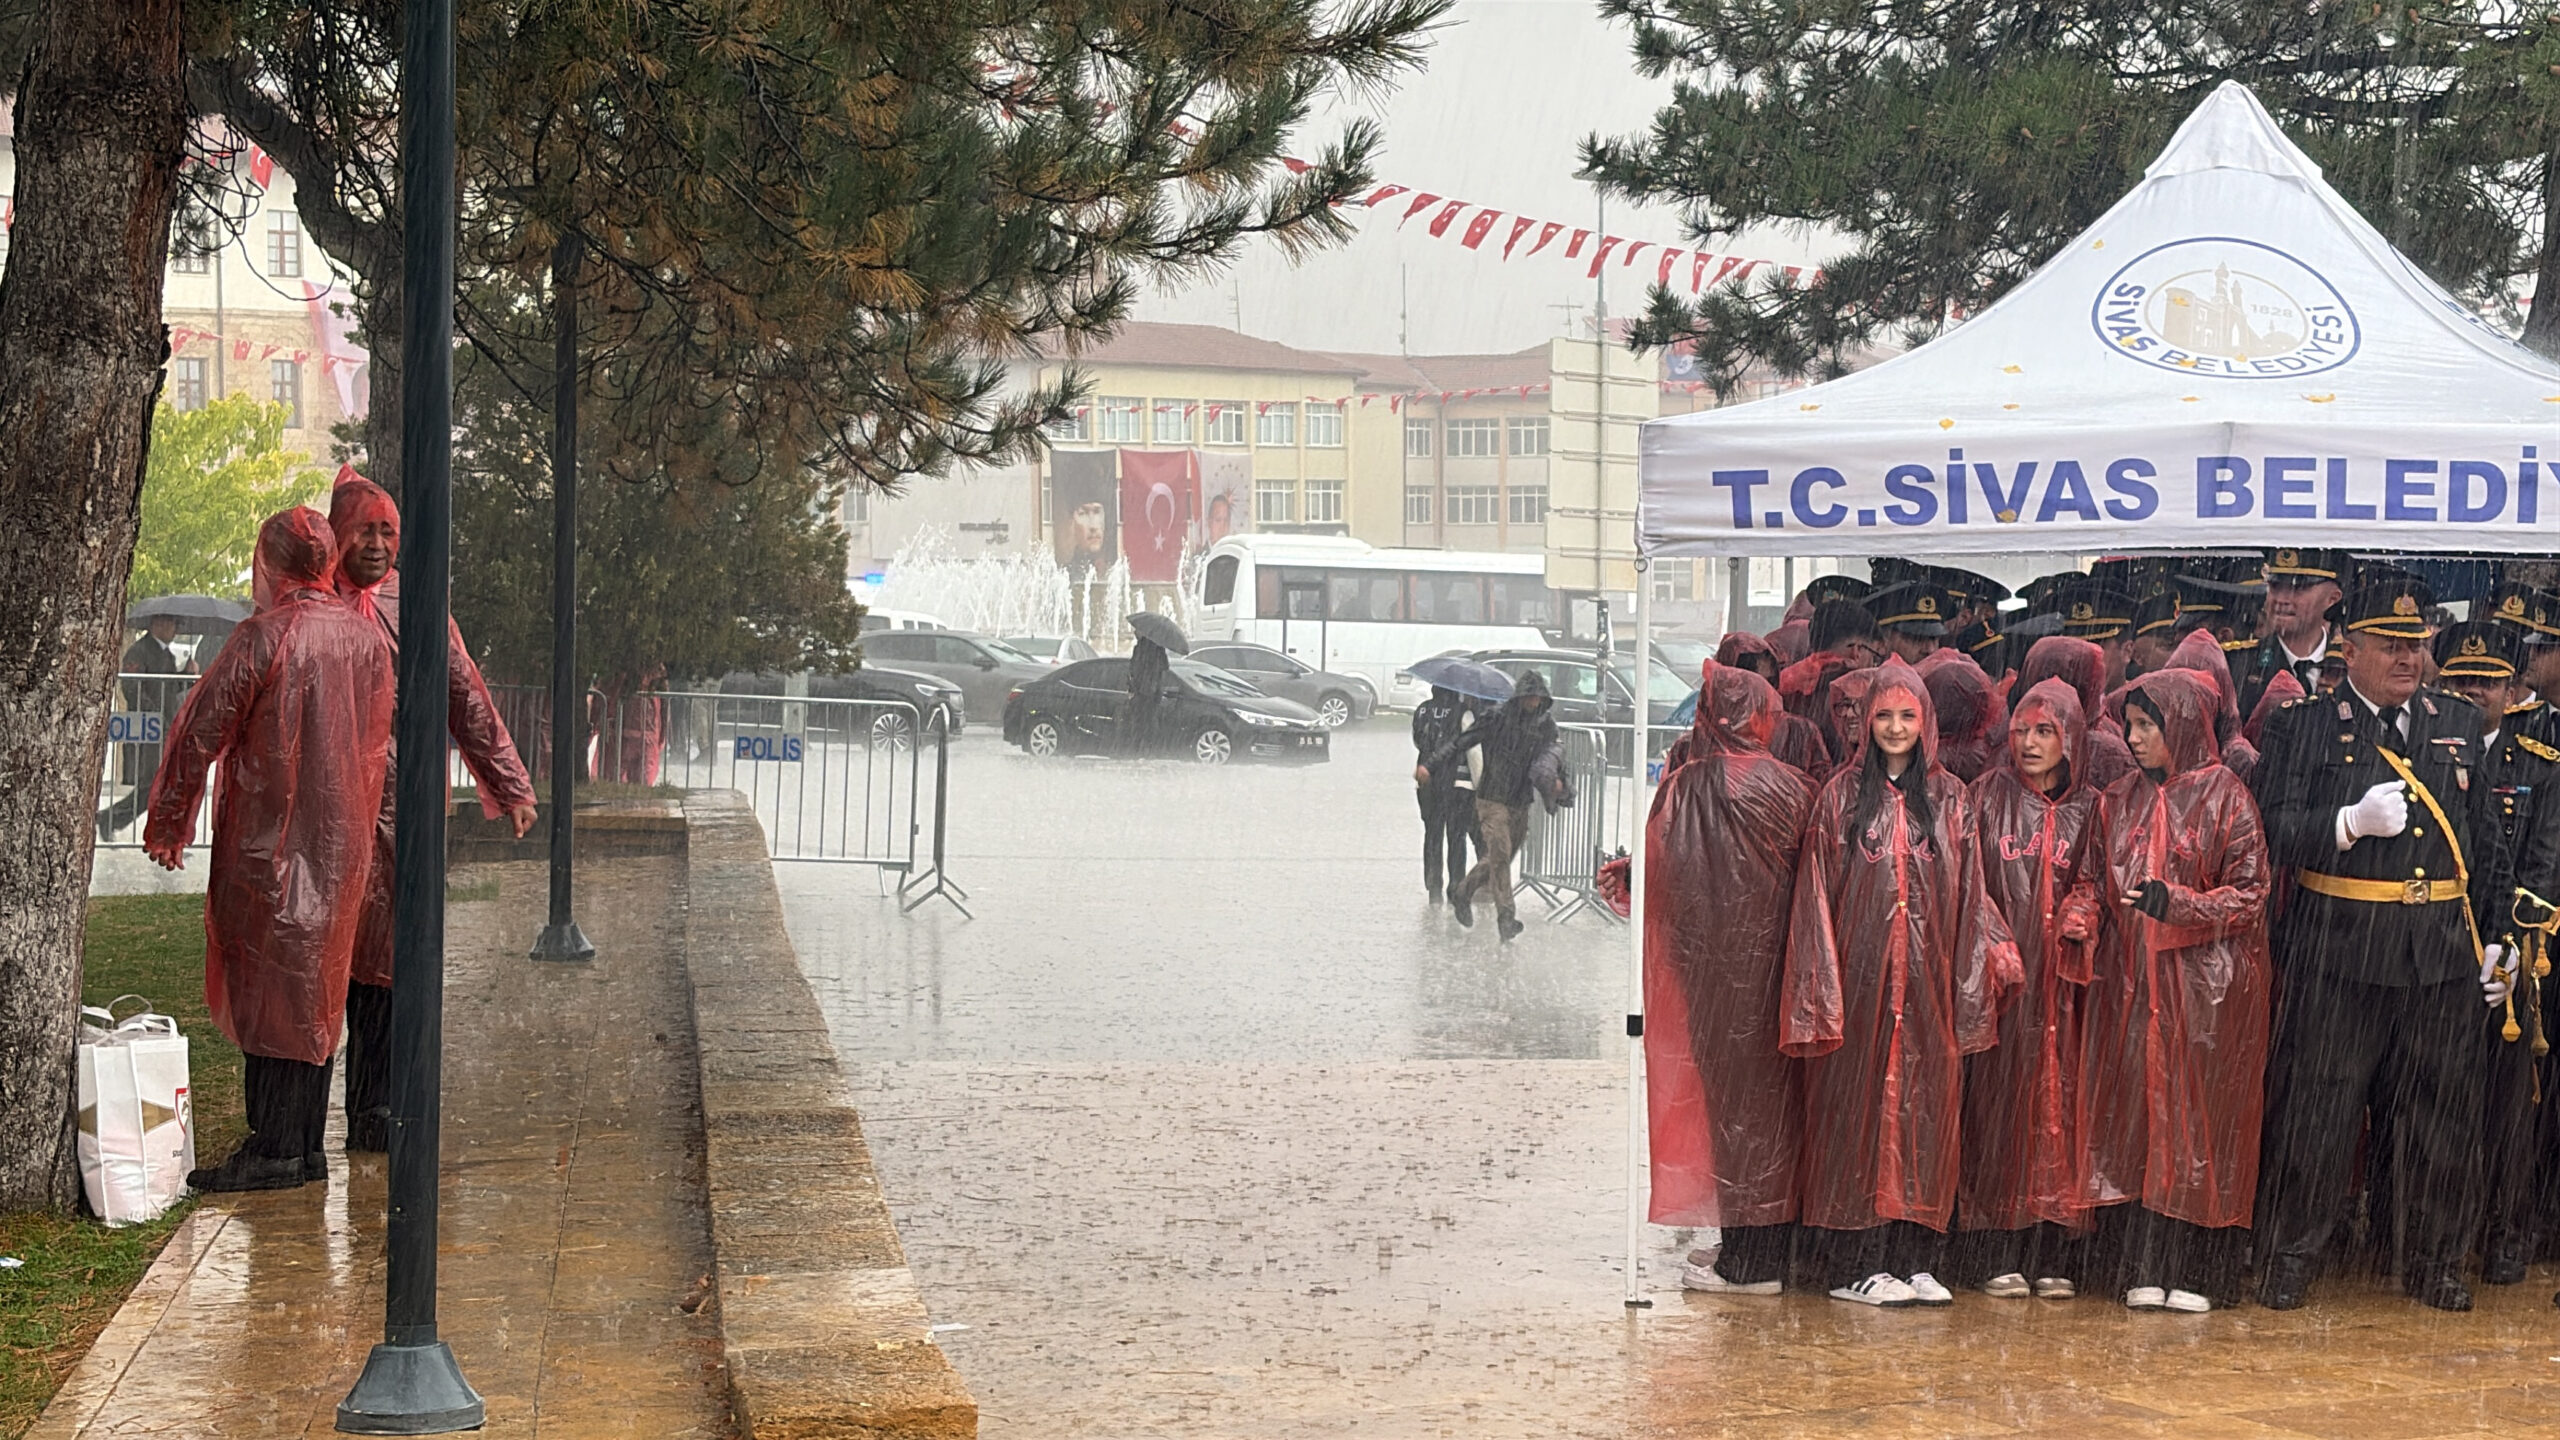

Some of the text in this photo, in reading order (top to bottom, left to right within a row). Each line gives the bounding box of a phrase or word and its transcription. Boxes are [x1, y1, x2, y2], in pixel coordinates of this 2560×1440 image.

[2250, 304, 2293, 318] 1828
[2105, 282, 2344, 374] SİVAS BELEDİYESİ
[2197, 445, 2560, 524] BELEDİ
[109, 713, 160, 742] OLİS
[737, 734, 802, 761] POLİS
